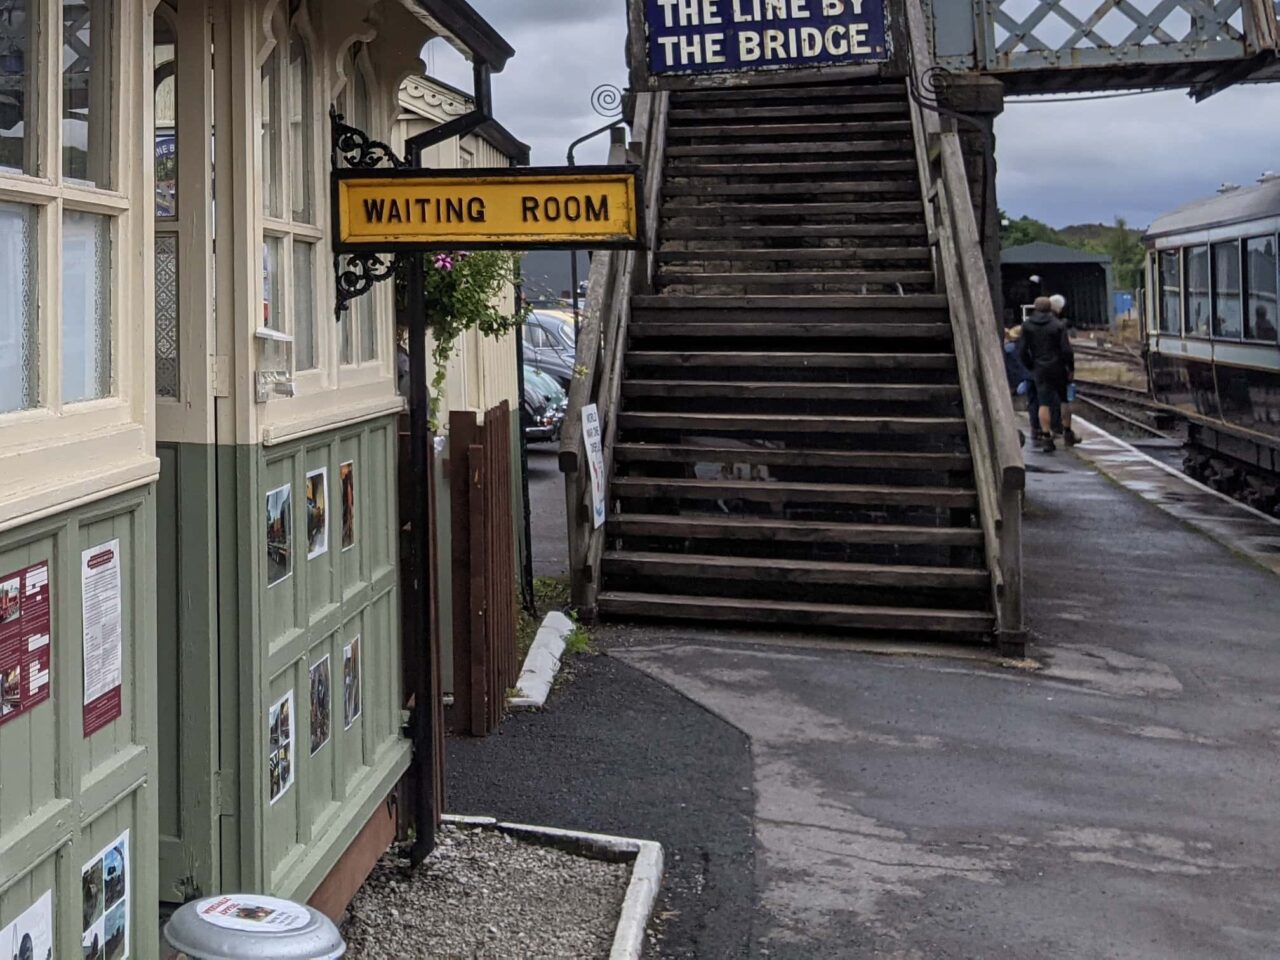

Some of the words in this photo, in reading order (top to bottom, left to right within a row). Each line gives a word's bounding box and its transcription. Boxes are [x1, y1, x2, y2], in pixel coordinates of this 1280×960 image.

[657, 33, 726, 66] THE
[362, 196, 487, 224] WAITING
[521, 194, 610, 223] ROOM
